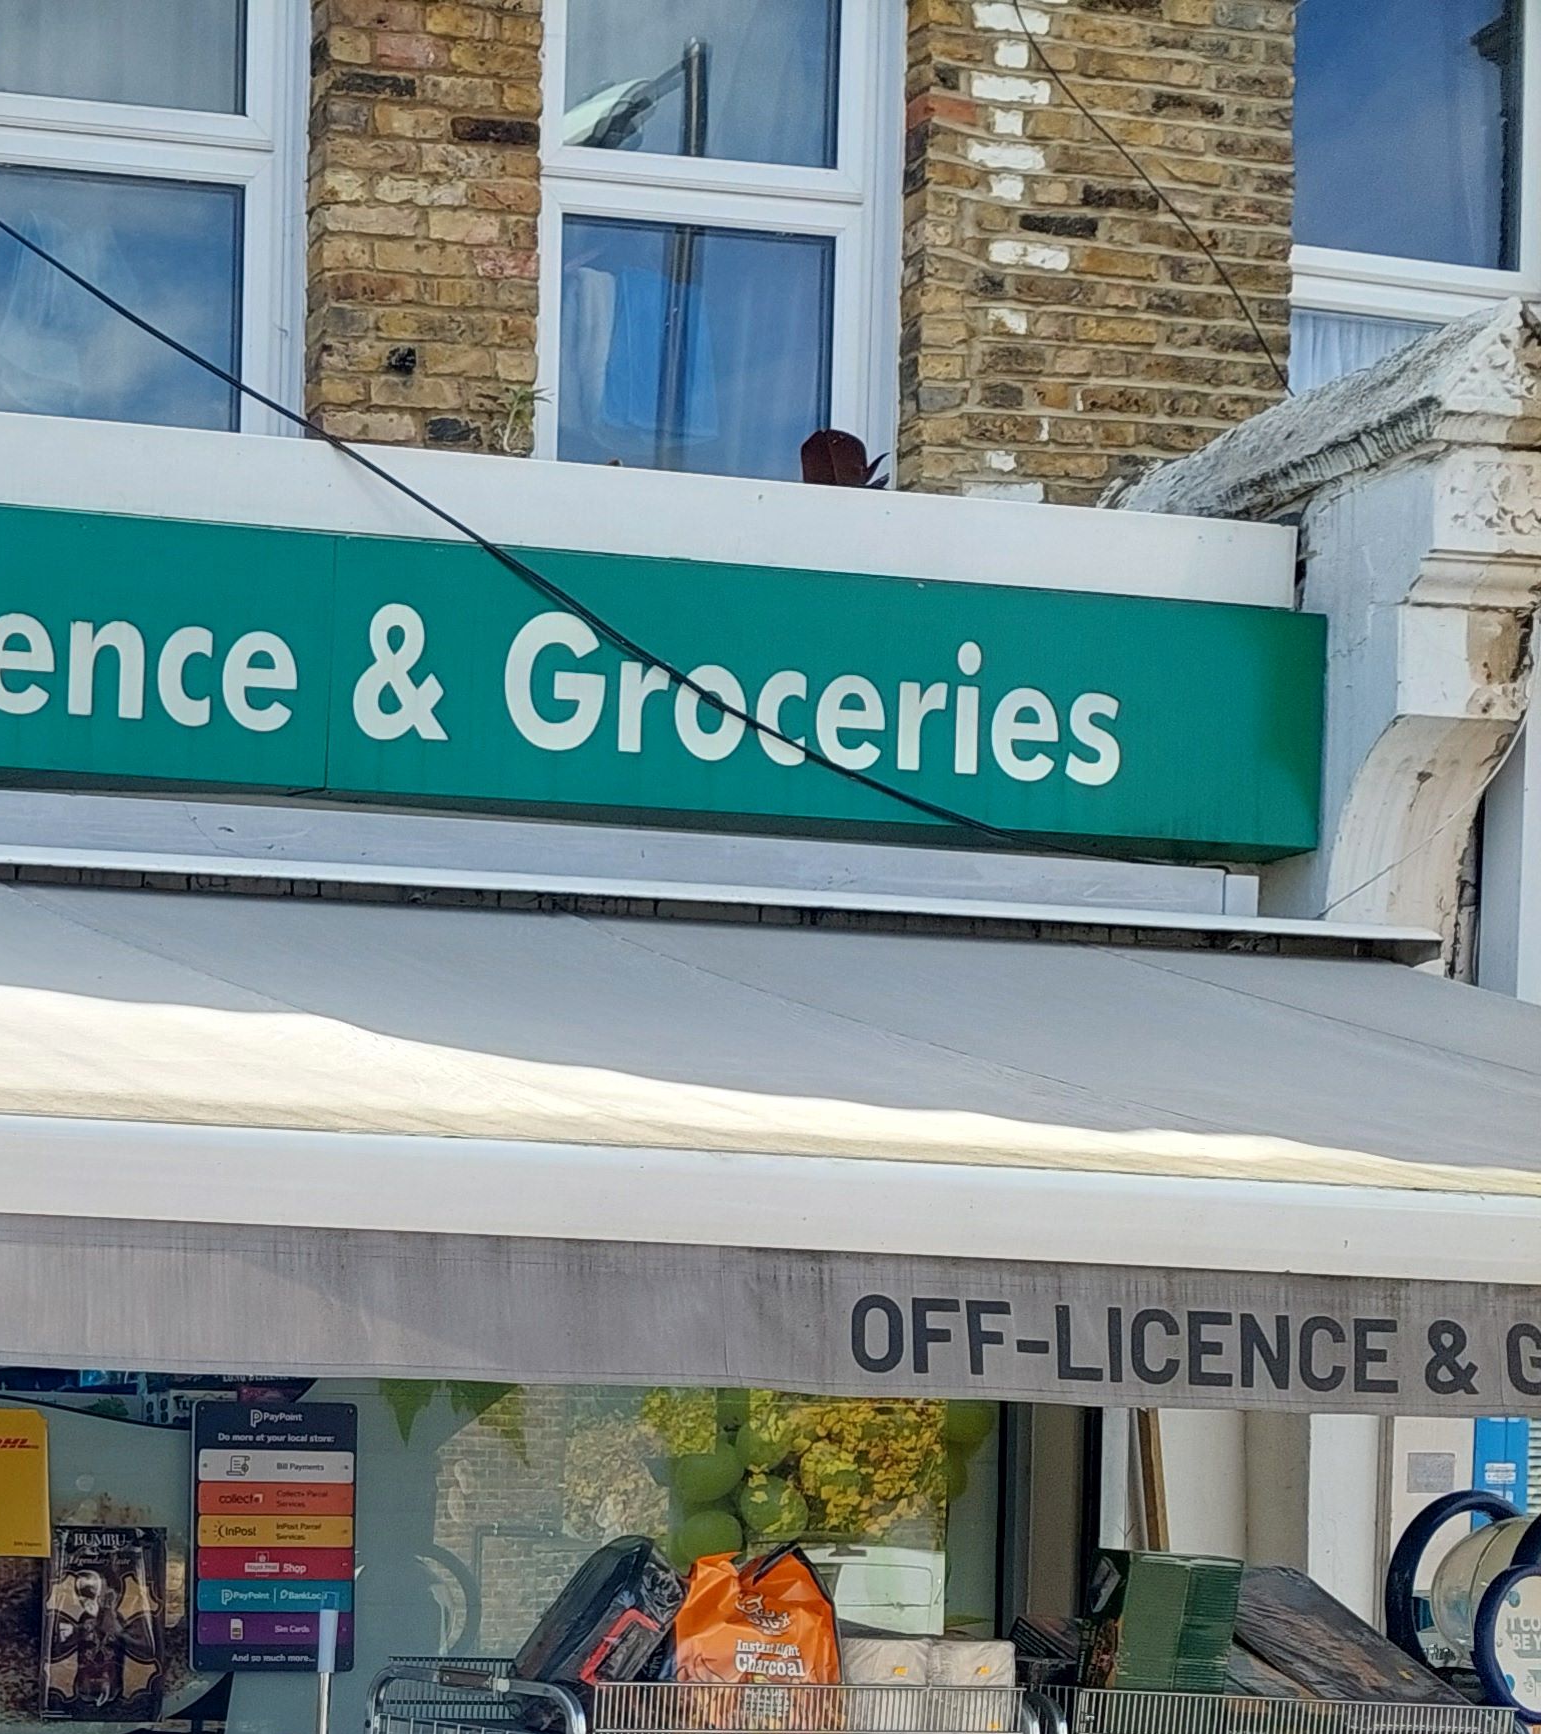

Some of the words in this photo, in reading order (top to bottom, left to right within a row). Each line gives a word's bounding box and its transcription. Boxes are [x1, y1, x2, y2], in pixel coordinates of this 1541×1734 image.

[352, 603, 449, 742] &
[504, 610, 1120, 786] Groceries
[851, 1295, 1400, 1393] OFF-LICENCE
[1425, 1320, 1480, 1395] &
[263, 1412, 303, 1423] PayPoint
[218, 1433, 231, 1442] Do
[255, 1434, 265, 1442] at
[267, 1435, 286, 1444] your
[288, 1434, 307, 1442] local
[276, 1463, 288, 1471] Bill
[289, 1463, 325, 1473] Payments
[225, 1525, 257, 1537] InPost
[73, 1532, 131, 1548] BUMBU
[282, 1563, 307, 1575] Shop
[233, 1591, 270, 1601] PayPoint
[290, 1625, 310, 1634] Cards
[1512, 1634, 1530, 1650] BE
[231, 1653, 250, 1662] And
[263, 1654, 286, 1662] much
[735, 1653, 806, 1678] Charcoal
